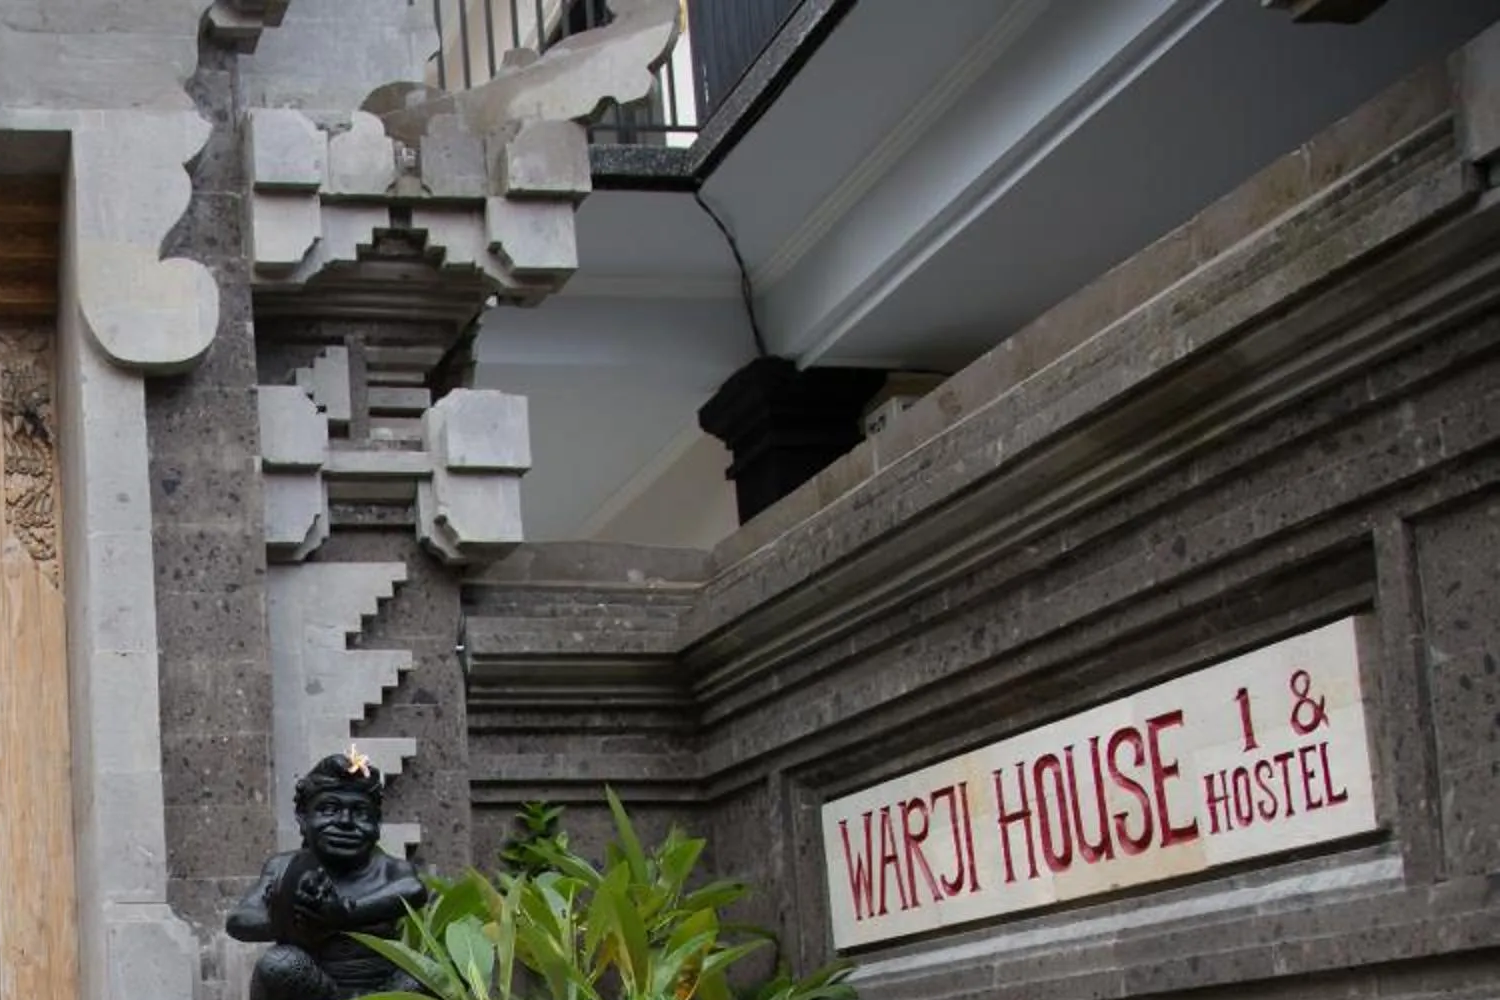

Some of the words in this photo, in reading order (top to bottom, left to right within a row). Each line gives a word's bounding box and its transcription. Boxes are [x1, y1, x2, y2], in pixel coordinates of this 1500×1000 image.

[838, 782, 982, 921] WARJI
[993, 709, 1200, 884] HOUSE
[1234, 687, 1260, 753] 1
[1288, 669, 1328, 736] &
[1202, 742, 1348, 836] HOSTEL
